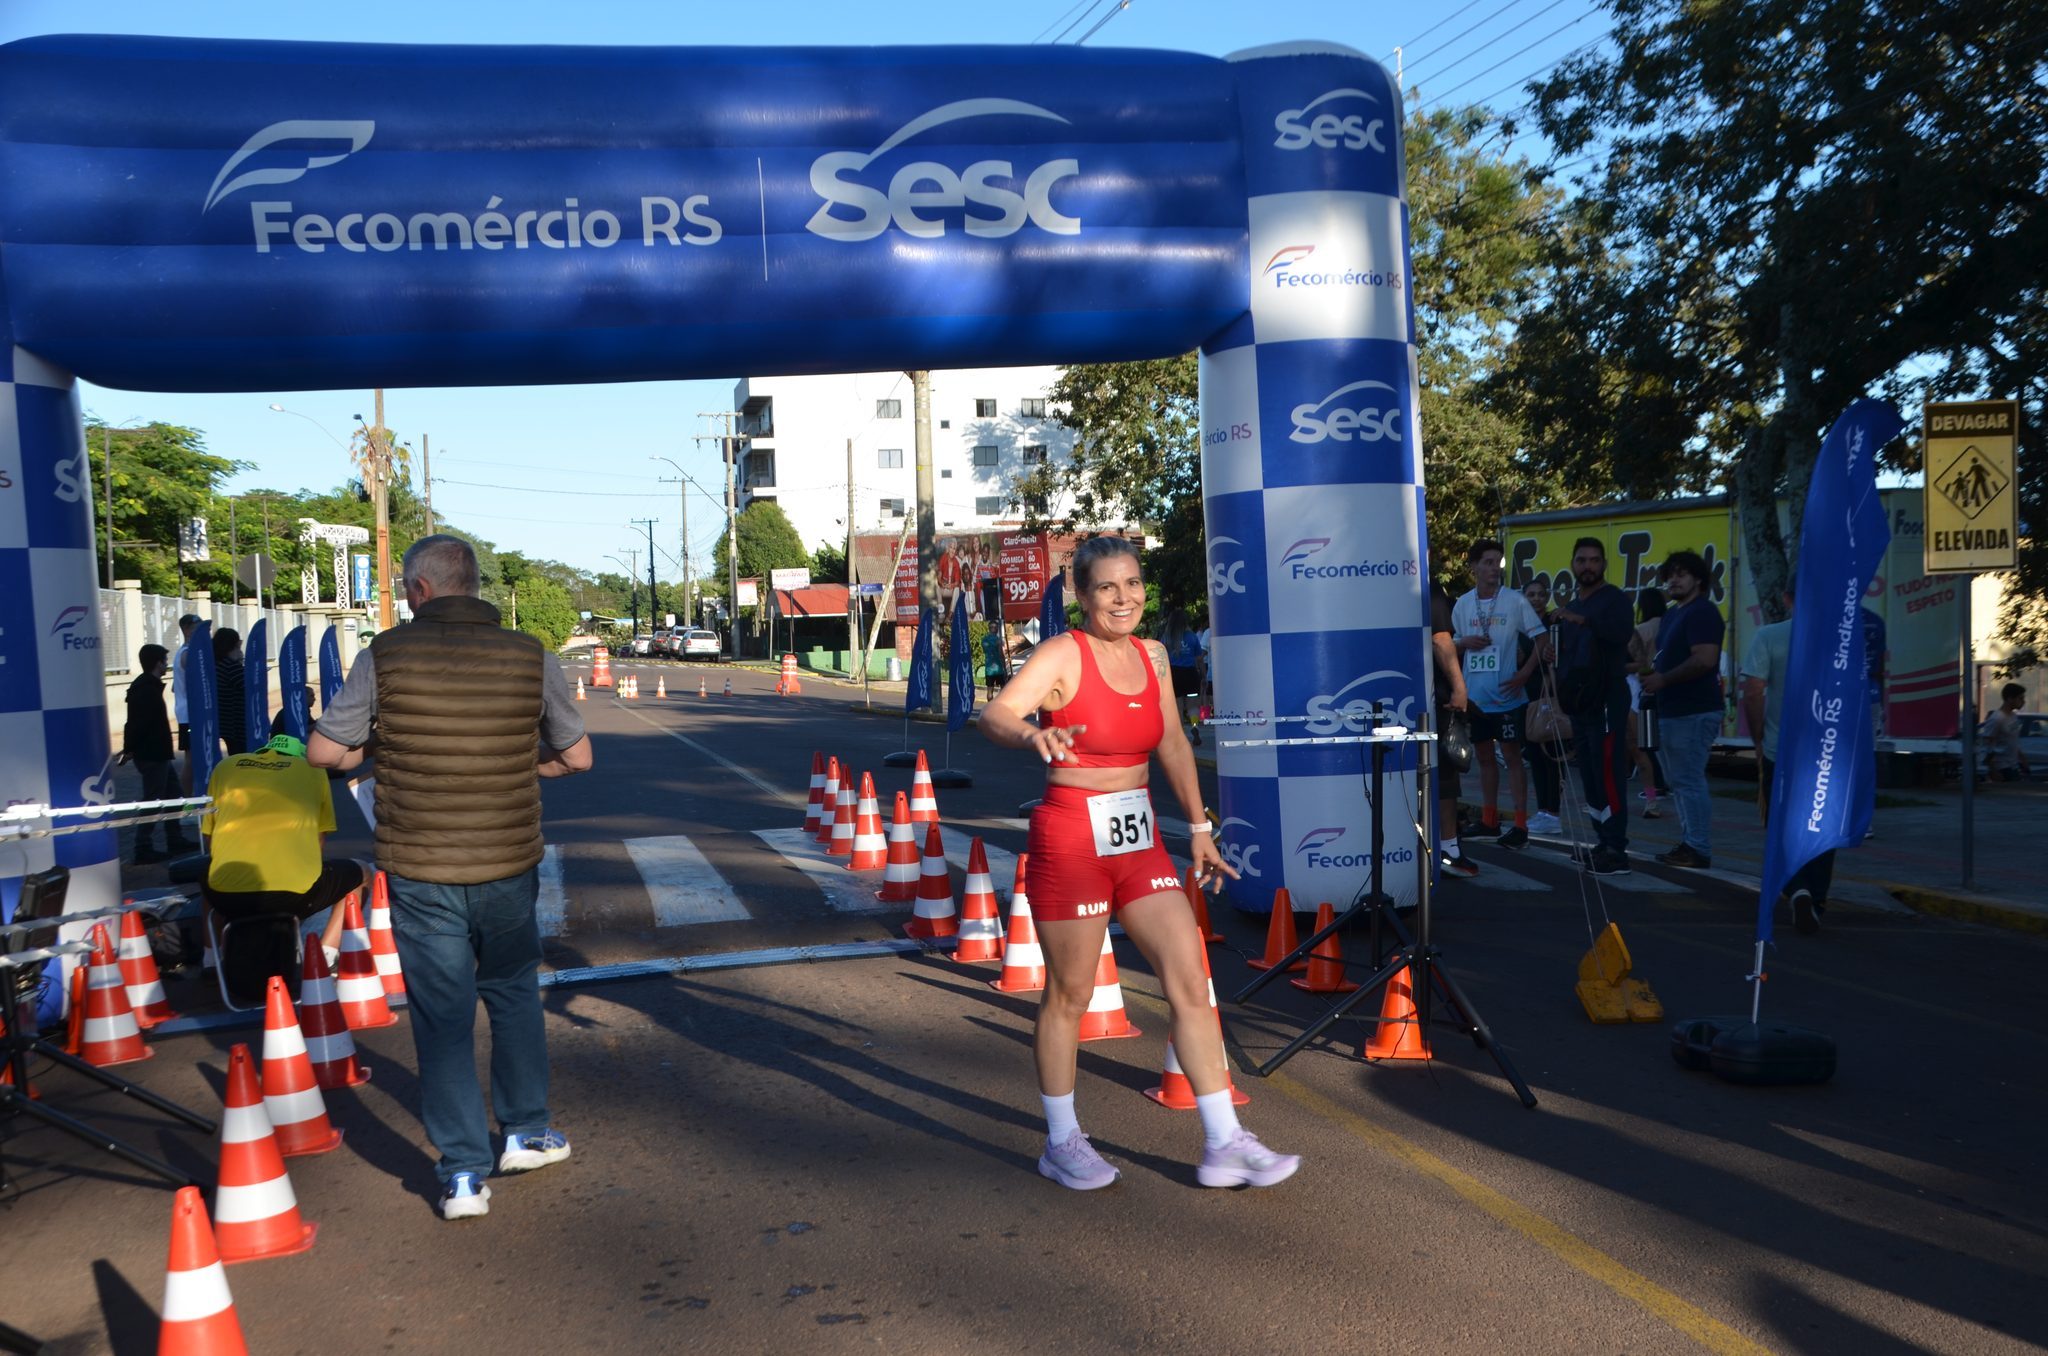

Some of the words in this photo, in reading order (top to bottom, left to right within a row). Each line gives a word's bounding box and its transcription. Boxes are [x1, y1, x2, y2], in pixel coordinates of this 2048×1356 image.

[1273, 109, 1386, 153] Sesc
[804, 149, 1082, 242] Sesc
[252, 196, 623, 254] Fecomércio
[641, 194, 723, 247] RS
[1276, 268, 1383, 288] Fecomércio
[1386, 273, 1402, 289] RS
[1231, 423, 1252, 441] RS
[1288, 403, 1402, 443] Sesc
[1932, 413, 2009, 432] DEVAGAR
[1935, 529, 2010, 552] ELEVADA
[1292, 559, 1398, 580] Fecomércio
[1402, 560, 1418, 578] RS
[1834, 577, 1859, 671] Sindicatos
[1470, 655, 1496, 669] 516
[1808, 727, 1838, 833] Fecomércio
[1824, 696, 1843, 724] RS
[1109, 811, 1150, 848] 851
[1308, 846, 1413, 868] Fecomrcio
[1077, 901, 1108, 917] RUN
